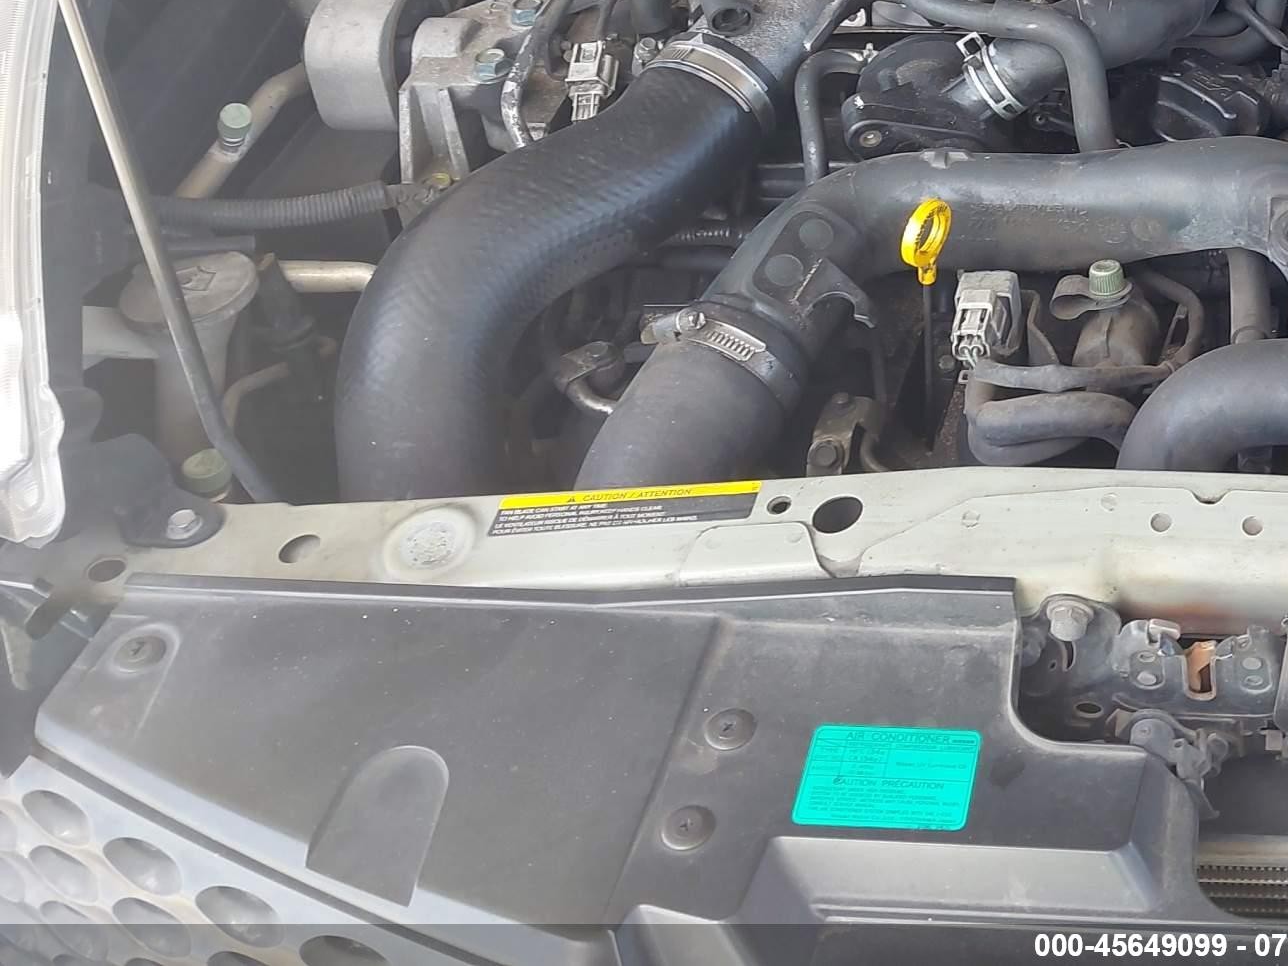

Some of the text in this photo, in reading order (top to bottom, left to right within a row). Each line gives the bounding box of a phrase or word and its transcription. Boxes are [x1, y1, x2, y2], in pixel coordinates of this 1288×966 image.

[582, 492, 625, 502] CAUTION
[638, 488, 693, 499] ATTENTION
[846, 731, 865, 741] AIR
[871, 732, 951, 744] CONDITIONER
[881, 778, 945, 791] PRÉCAUTION
